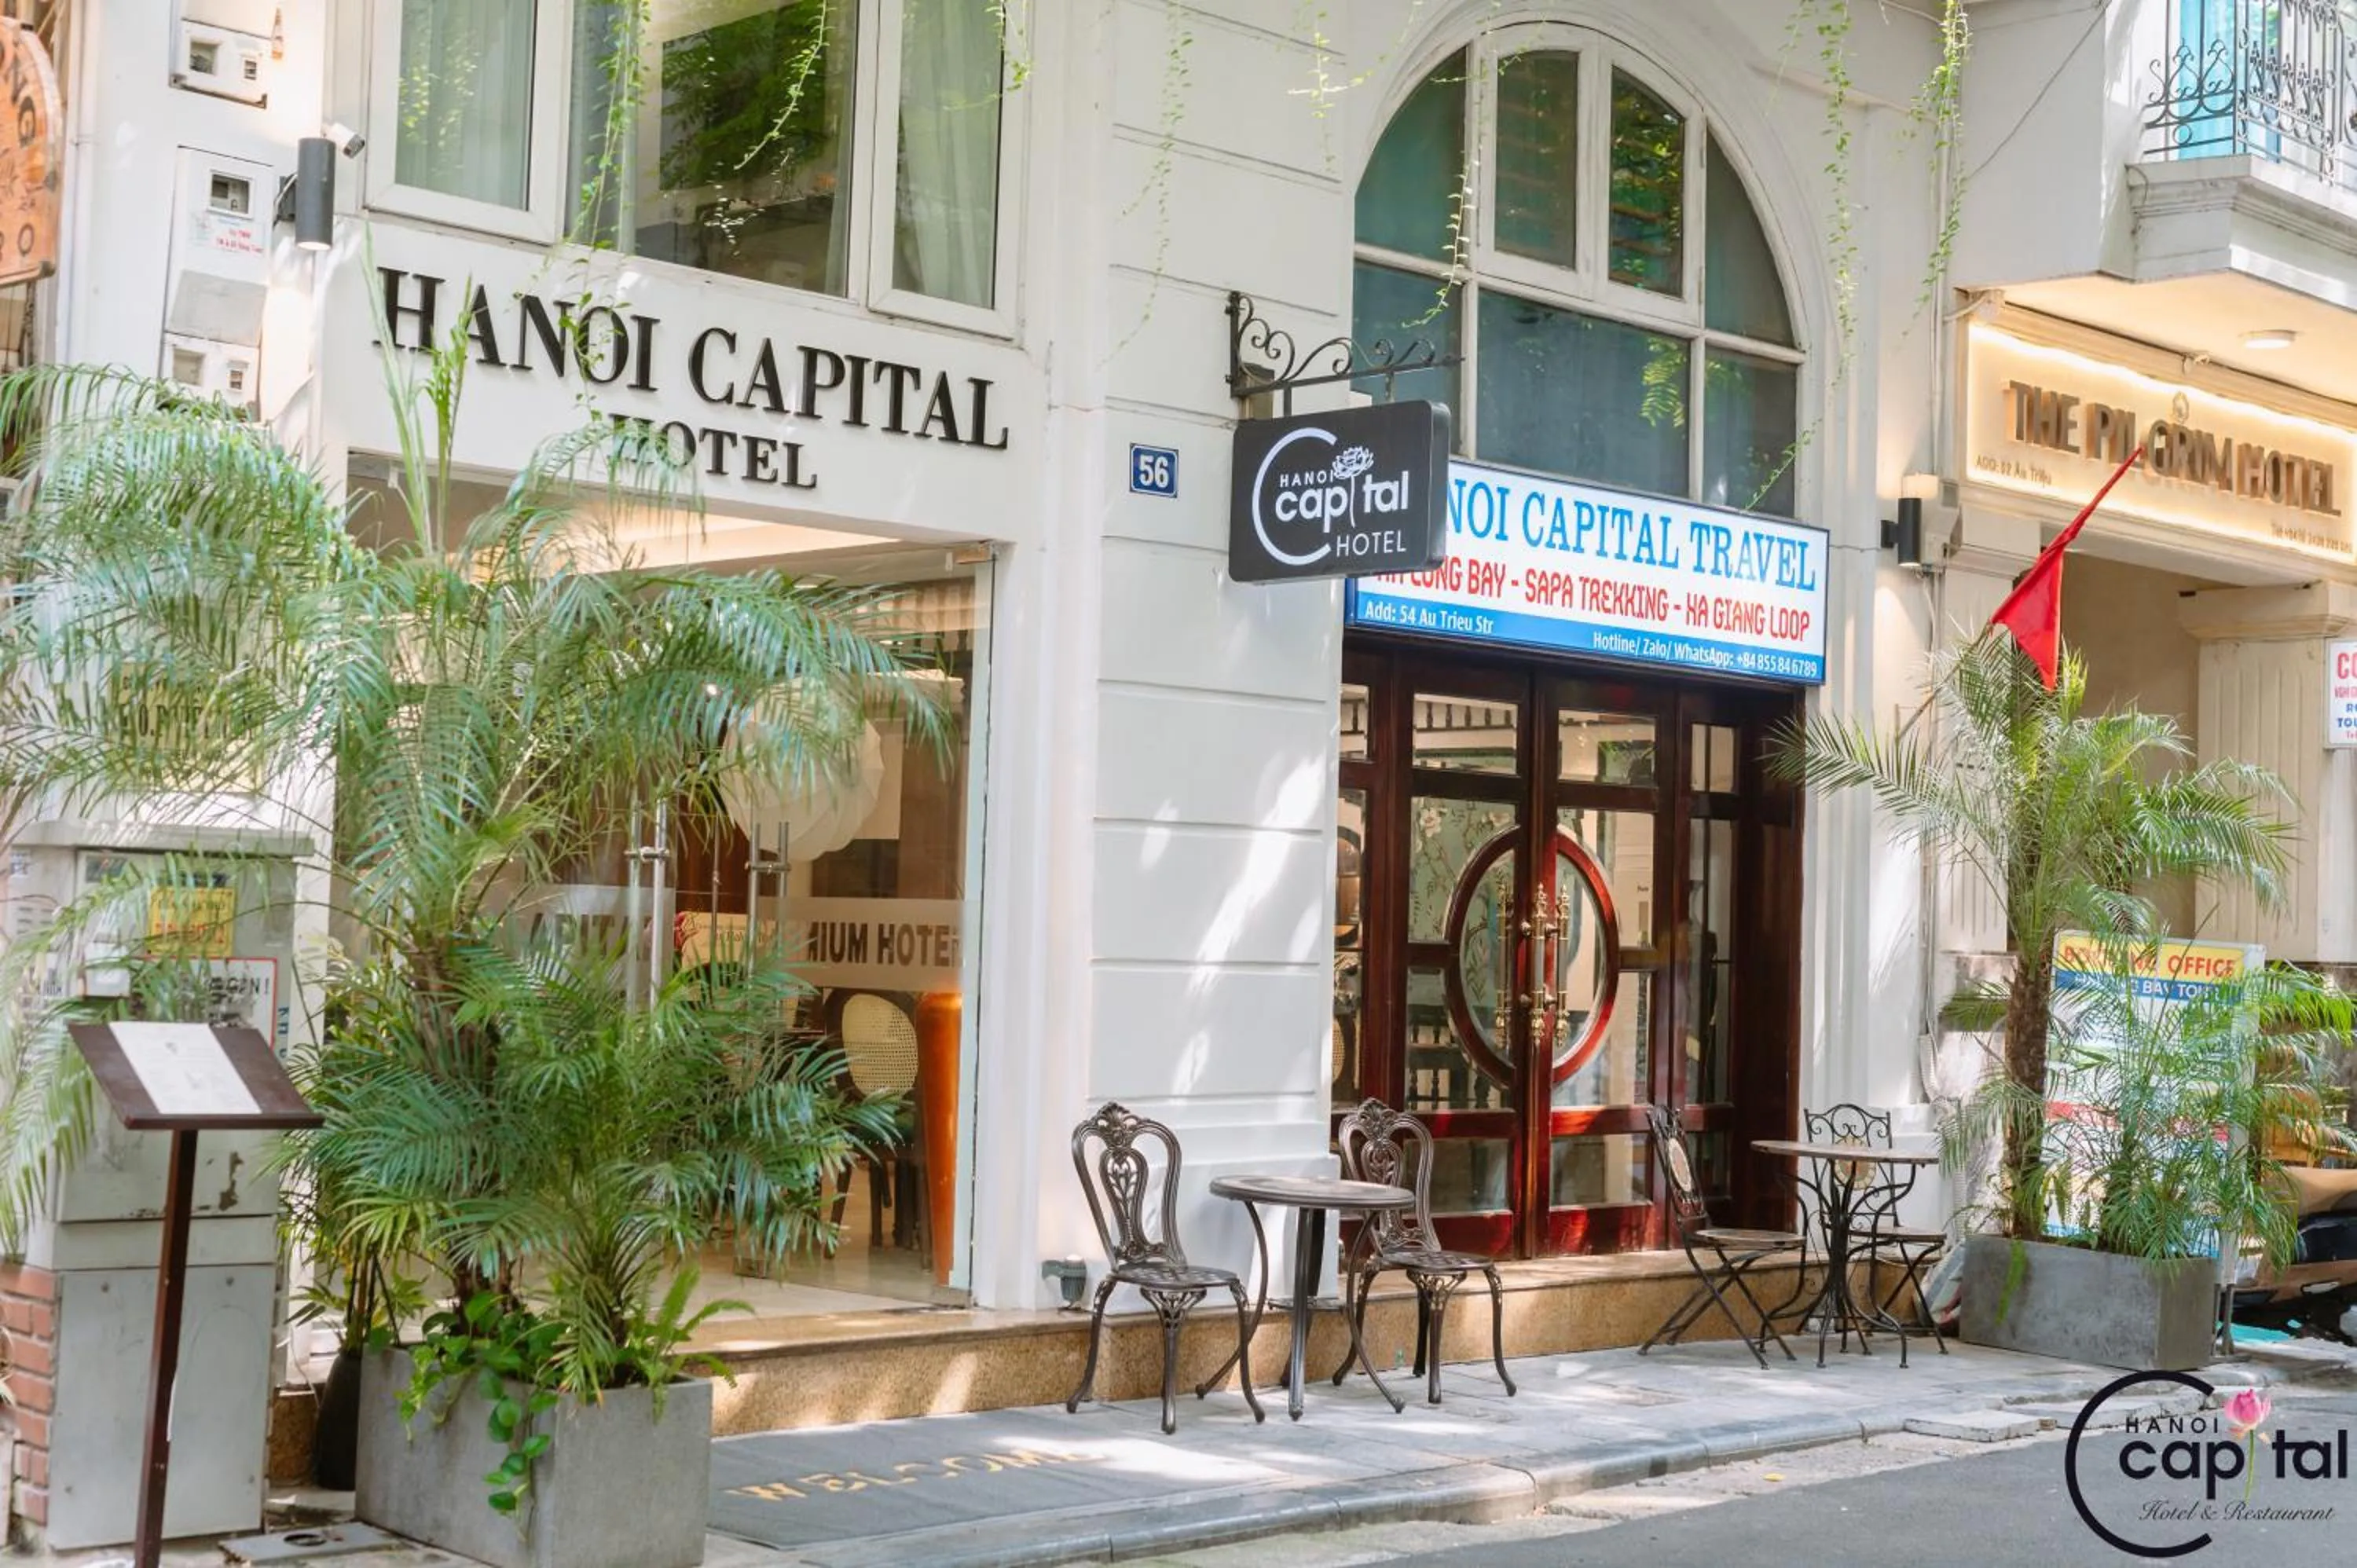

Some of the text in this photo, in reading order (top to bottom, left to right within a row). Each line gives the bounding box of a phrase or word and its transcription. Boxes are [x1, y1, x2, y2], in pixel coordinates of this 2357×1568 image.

[372, 266, 1009, 450] HANOI CAPITAL
[607, 414, 818, 489] HOTEL
[2003, 380, 2080, 454] THE
[2237, 442, 2341, 517] HOTEL
[1138, 454, 1169, 488] 56
[1279, 471, 1336, 488] HANOI
[1336, 530, 1406, 557] HOTEL
[1523, 492, 1679, 570] CAPITAL
[1690, 522, 1816, 591] TRAVEL
[1365, 600, 1494, 634] Add: 54 Au Trieu Str
[1468, 559, 1506, 598] BAY
[1525, 568, 1574, 608] SAPA
[1579, 576, 1670, 621] TREKKING
[1686, 592, 1708, 628] HA
[1714, 597, 1767, 635] GIANG
[1770, 606, 1810, 642] LOOP
[1593, 632, 1640, 654] Hotline/
[1674, 644, 1734, 669] WhatsApp:
[2167, 954, 2236, 978] OFFICE
